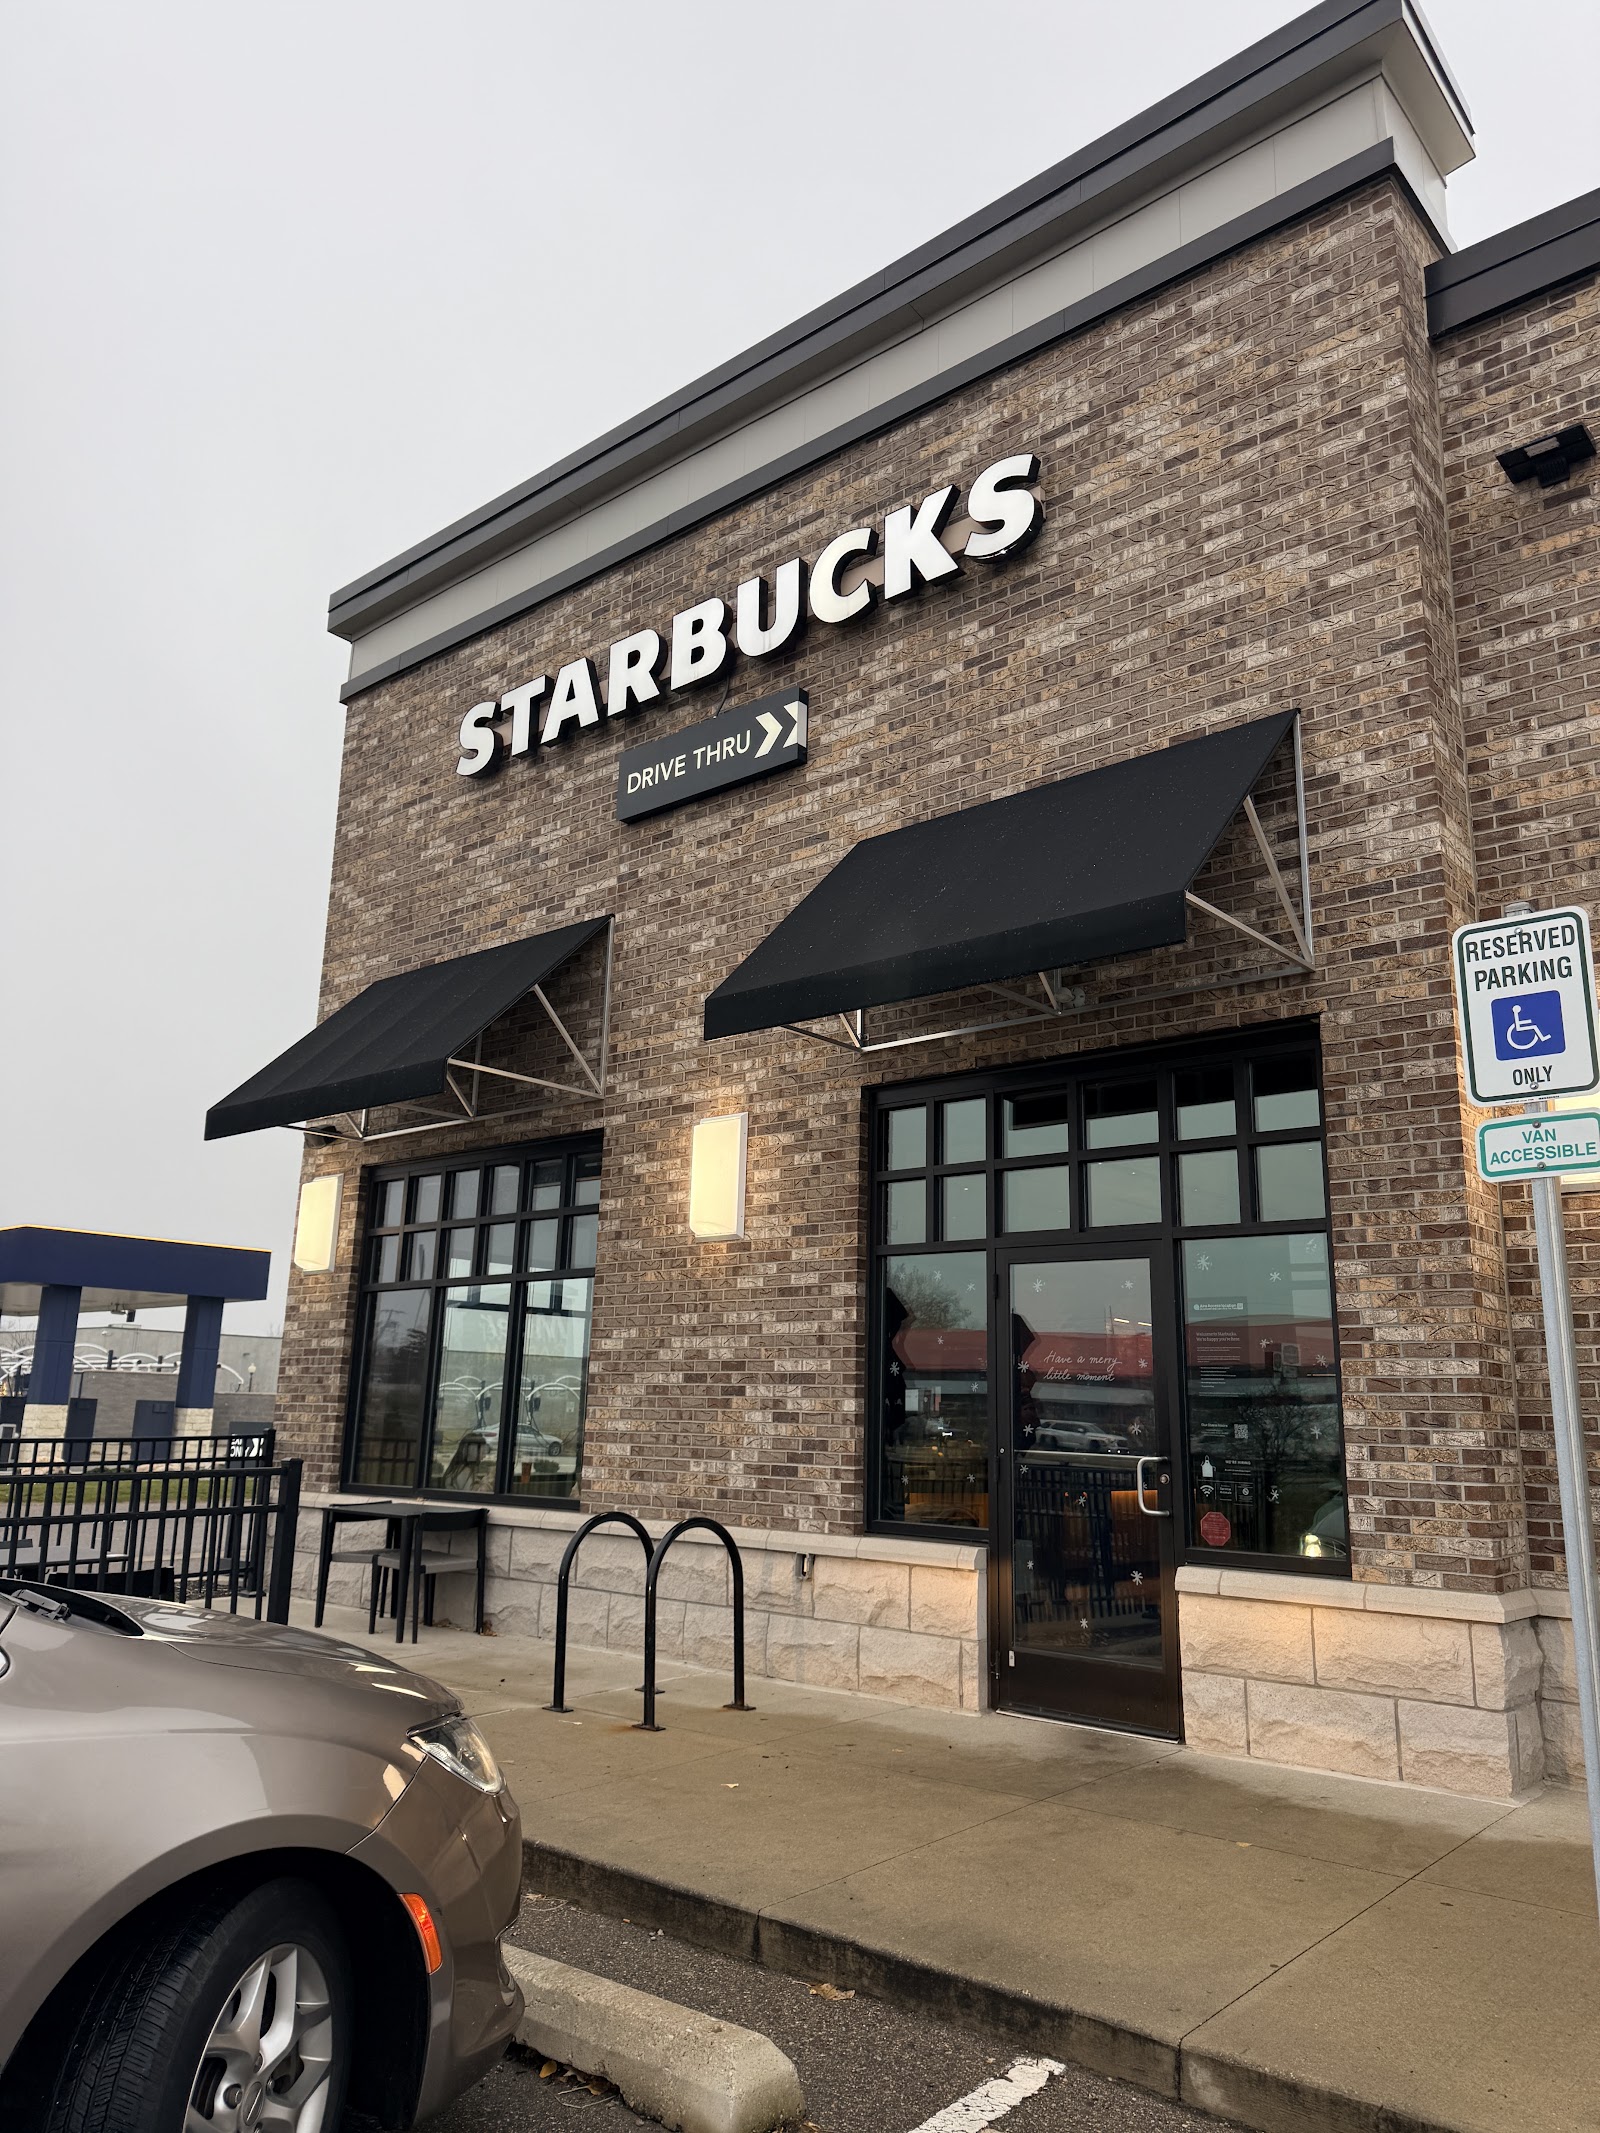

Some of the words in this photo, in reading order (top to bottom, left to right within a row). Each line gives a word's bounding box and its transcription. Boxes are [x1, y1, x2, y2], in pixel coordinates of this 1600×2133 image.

[456, 453, 1042, 778] STARBUCKS
[627, 754, 687, 794] DRIVE
[692, 729, 751, 770] THRU
[1465, 924, 1575, 962] RESERVED
[1474, 956, 1573, 991] PARKING
[1512, 1065, 1553, 1086] ONLY
[1521, 1128, 1557, 1143] VAN
[1490, 1142, 1597, 1165] ACCESSIBLE
[1043, 1350, 1072, 1364] Have
[1077, 1355, 1085, 1363] a
[1089, 1355, 1122, 1372] merry
[1043, 1366, 1071, 1380] little
[1076, 1370, 1115, 1382] moment
